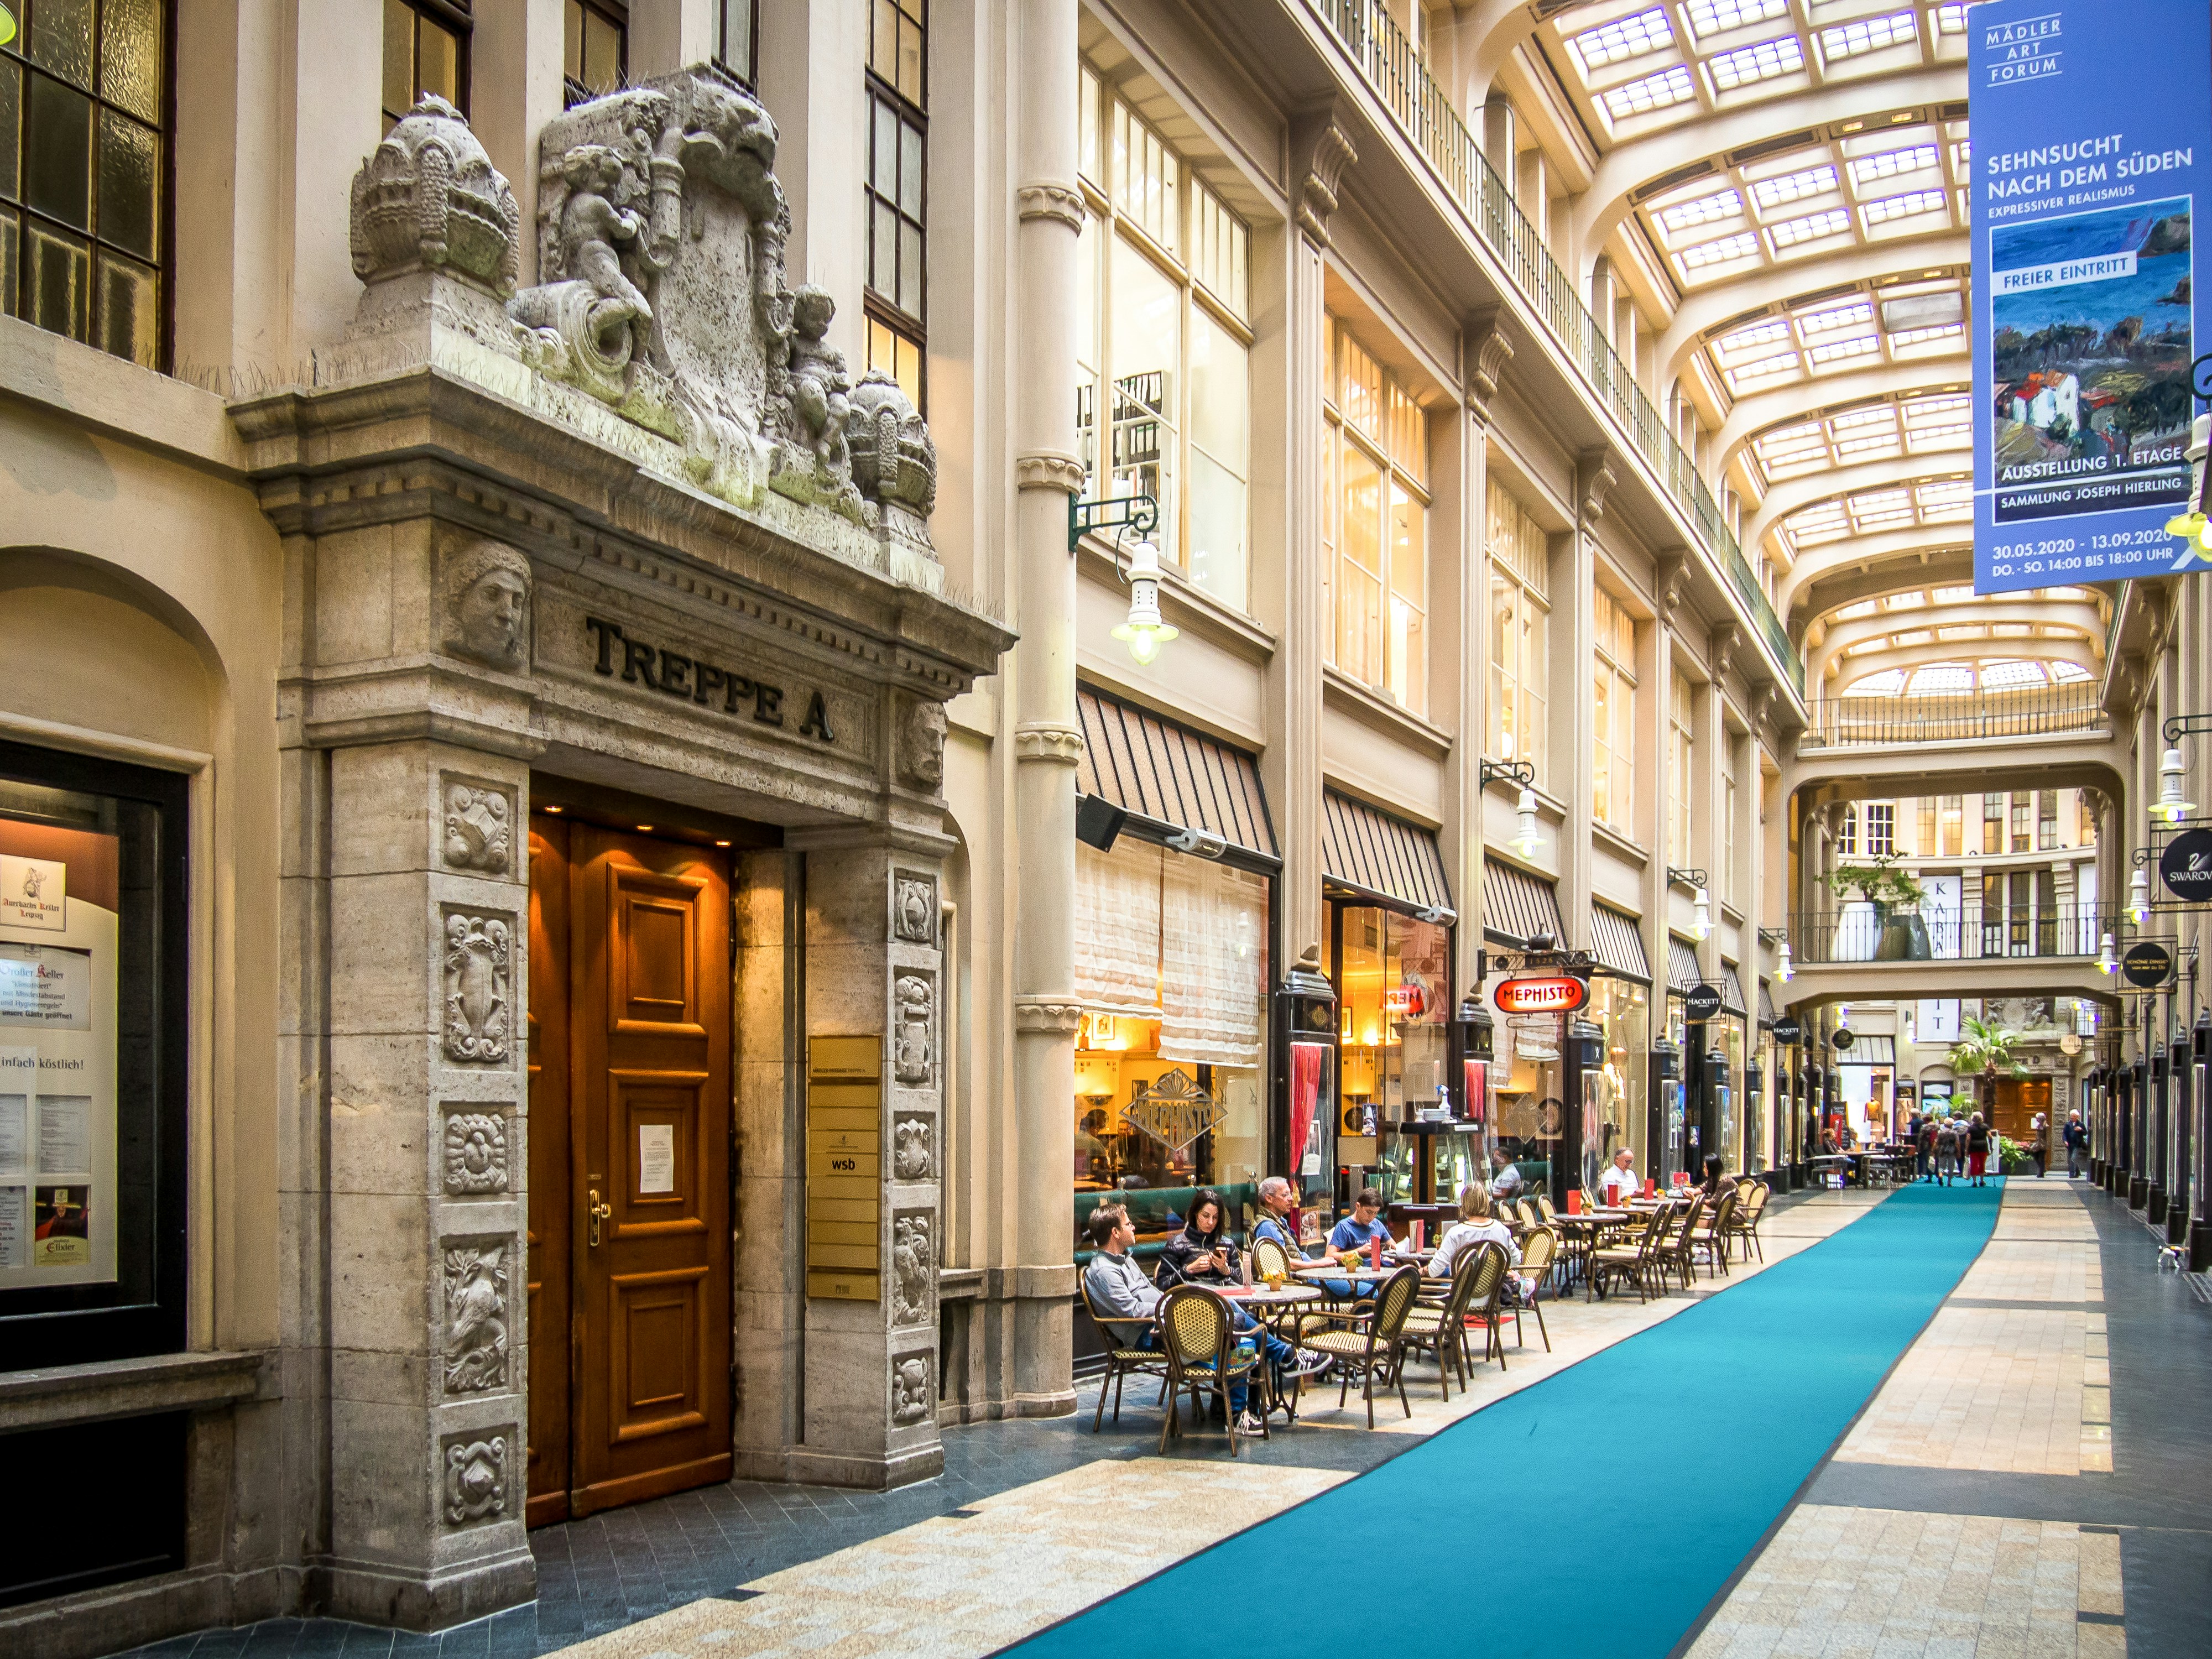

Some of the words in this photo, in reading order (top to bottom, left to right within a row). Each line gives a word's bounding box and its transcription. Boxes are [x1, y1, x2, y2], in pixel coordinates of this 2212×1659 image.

[1986, 19, 2061, 46] MÄDLER
[2007, 42, 2041, 60] ART
[1991, 58, 2056, 82] FORUM
[1988, 133, 2123, 175] SEHNSUCHT
[1988, 174, 2050, 201] NACH
[2060, 163, 2107, 188] DEM
[2116, 148, 2193, 178] SÜDEN
[1989, 196, 2063, 219] EXPRESSIVER
[2068, 185, 2135, 206] REALISMUS
[2004, 269, 2053, 288] FREIER
[2060, 258, 2128, 280] EINTRITT
[2001, 456, 2107, 481] AUSSTELLUNG
[2115, 454, 2126, 468] 1.
[2133, 446, 2182, 466] ETAGE
[2001, 489, 2072, 509] SAMMLUNG
[2075, 484, 2121, 500] JOSEPH
[2125, 478, 2182, 493] HIERLING
[1992, 539, 2074, 560] 30.05.2020
[2091, 529, 2173, 549] 13.09.2020
[1992, 564, 2015, 577] DO.
[2024, 561, 2045, 573] SO.
[2048, 556, 2081, 571] 14:00
[2085, 554, 2104, 567] BIS
[2108, 550, 2142, 564] 18:00
[2146, 547, 2173, 560] UHR
[586, 616, 784, 726] TREPPE
[799, 690, 834, 740] A
[2170, 871, 2212, 882] SWAROV
[36, 964, 64, 979] Keller
[1504, 987, 1575, 1003] MEPHISTO
[39, 1057, 84, 1070] köstlich!
[1138, 1100, 1212, 1145] MEPHISTO
[832, 1157, 856, 1170] wsb
